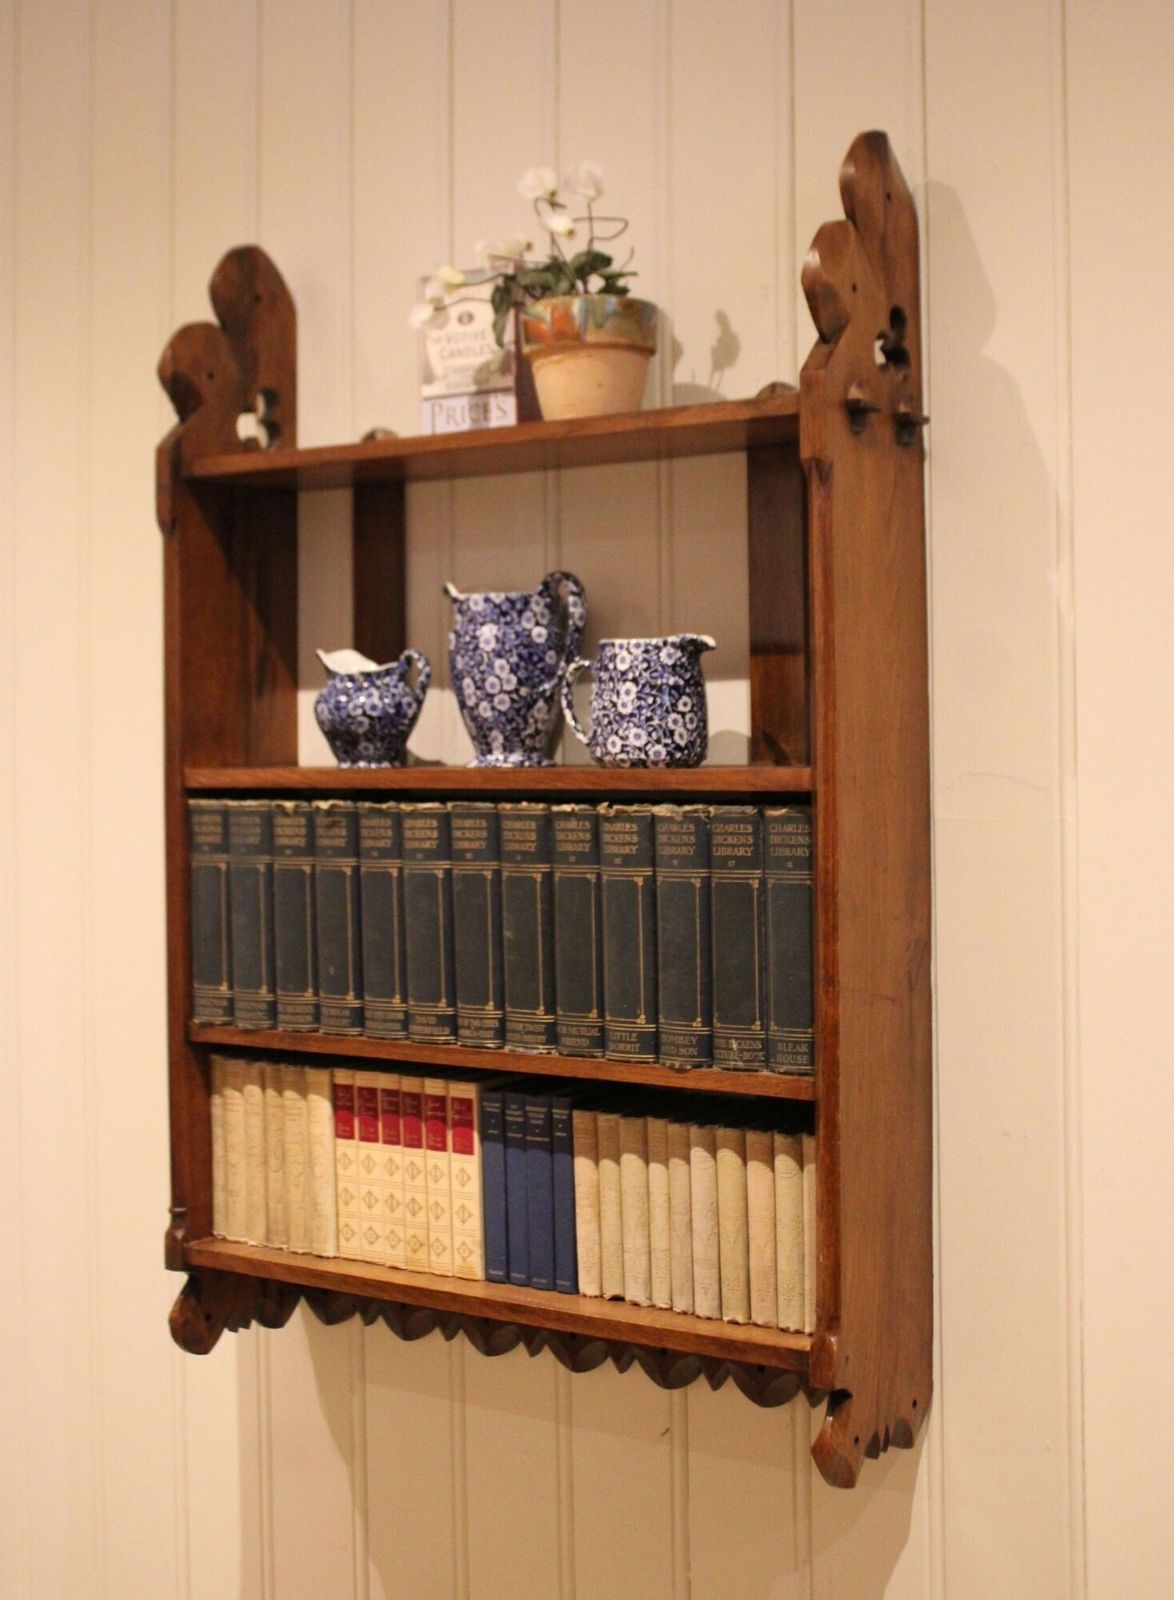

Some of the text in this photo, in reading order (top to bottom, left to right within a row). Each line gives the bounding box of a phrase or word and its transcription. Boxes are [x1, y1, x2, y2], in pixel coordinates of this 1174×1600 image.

[712, 823, 753, 833] CHARLES
[713, 834, 753, 844] DICKENS
[713, 846, 754, 856] LIBRARY
[609, 1031, 638, 1041] LITTLE
[679, 1047, 698, 1055] SON
[777, 1042, 809, 1052] BLEAK
[776, 1053, 809, 1064] HOUSE
